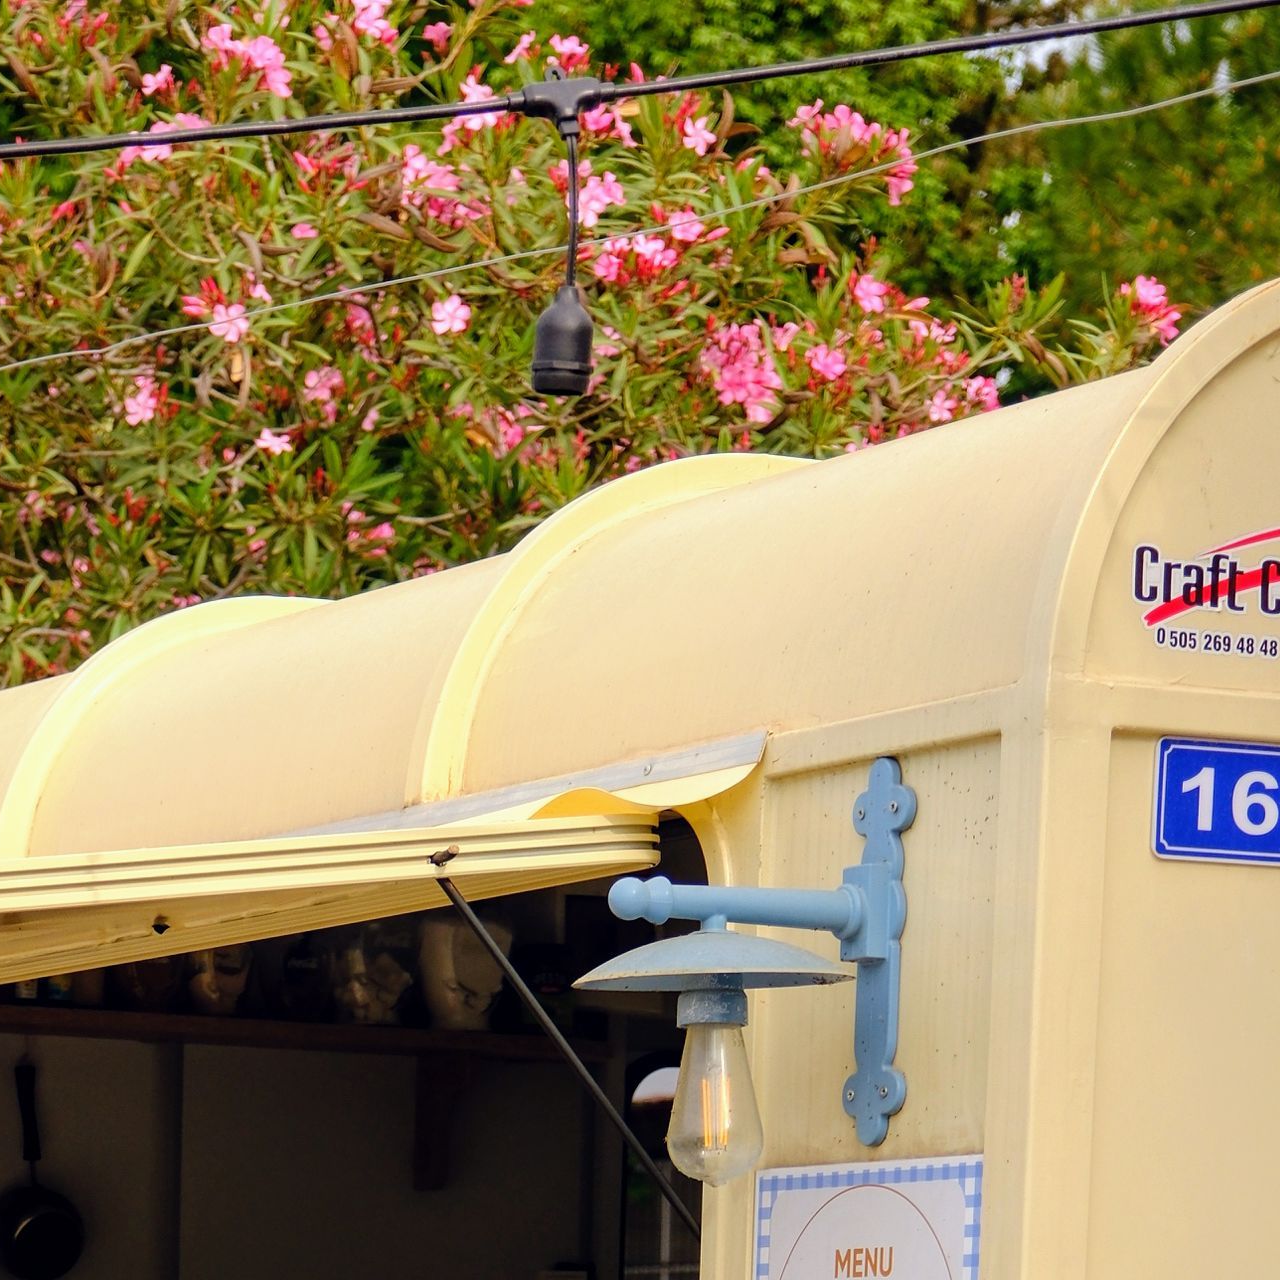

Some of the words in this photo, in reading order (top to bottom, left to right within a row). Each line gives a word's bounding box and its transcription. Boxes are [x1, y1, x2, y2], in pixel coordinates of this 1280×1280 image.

[1134, 546, 1244, 612] Craft
[1156, 628, 1165, 644] 0
[1169, 630, 1196, 649] 505
[1204, 634, 1231, 652] 269
[1236, 636, 1254, 655] 48
[1259, 639, 1278, 656] 48
[834, 1246, 893, 1279] MENU
